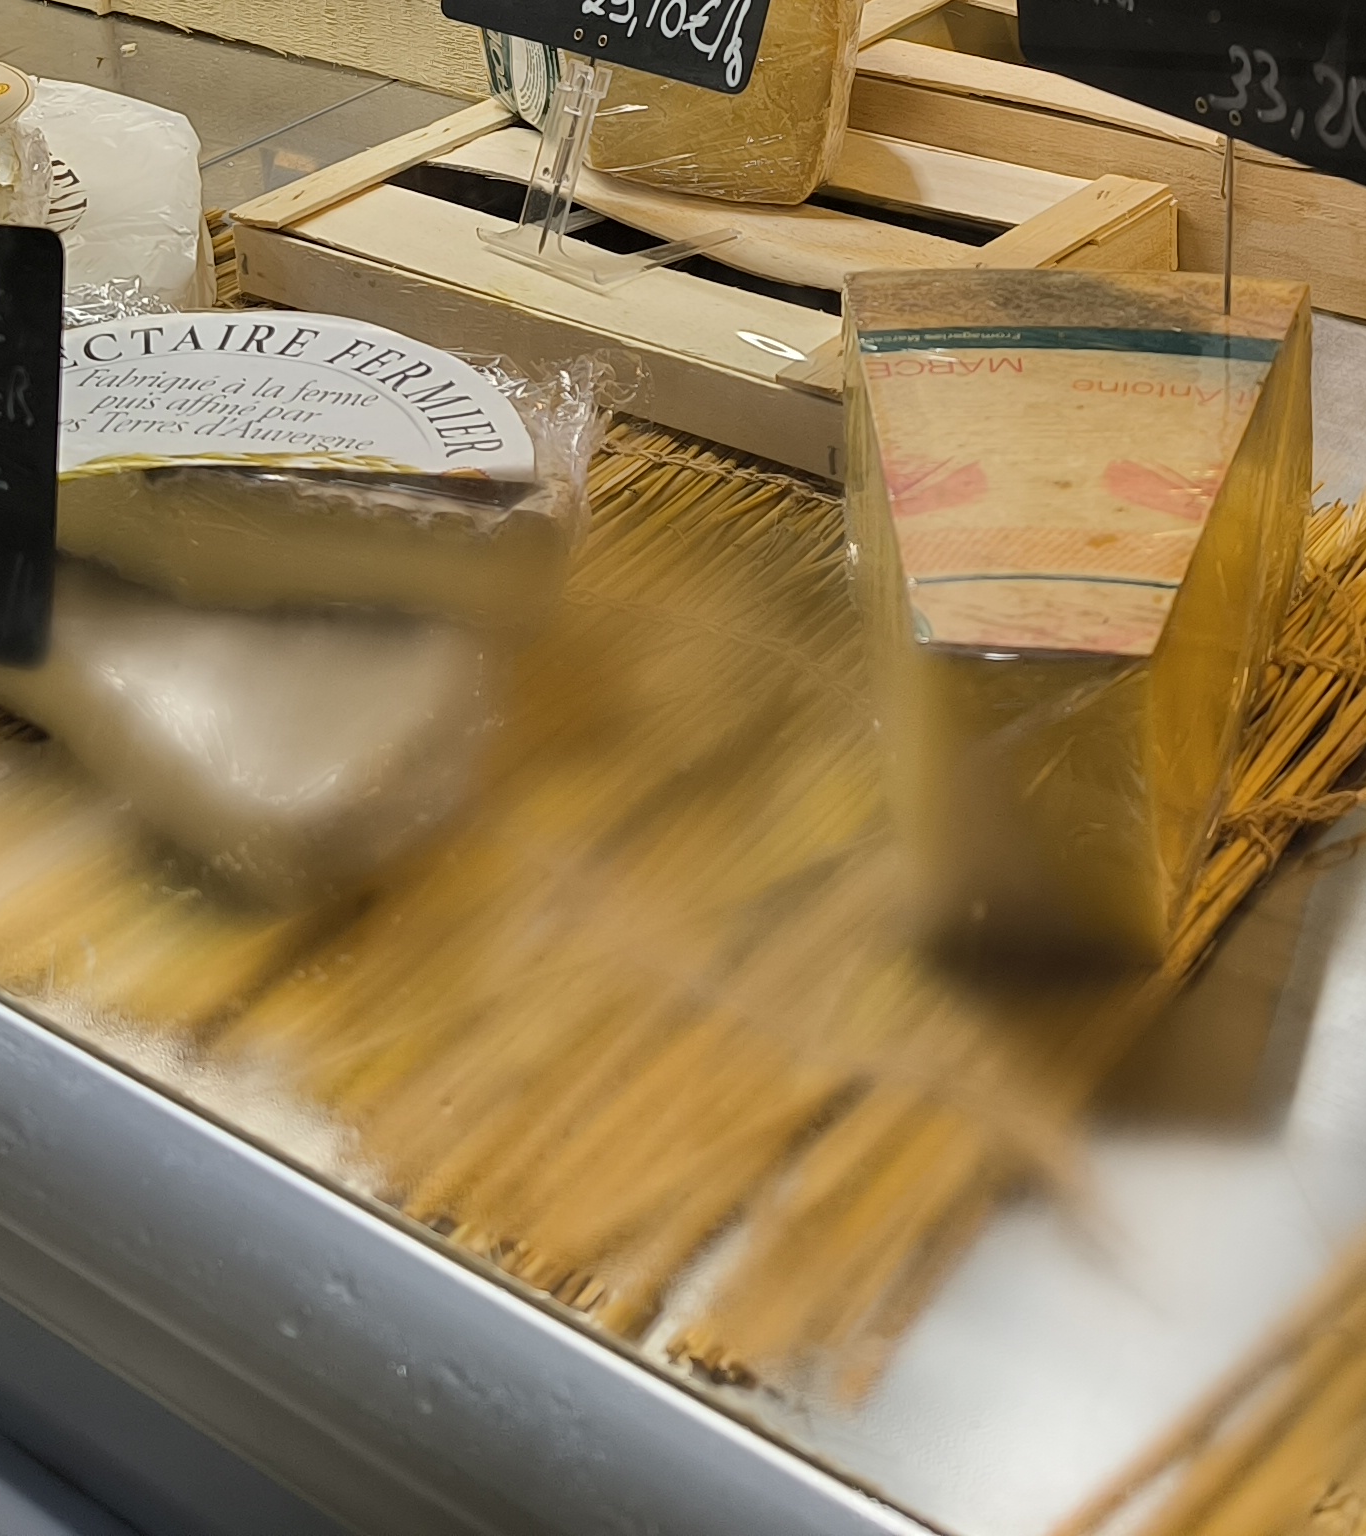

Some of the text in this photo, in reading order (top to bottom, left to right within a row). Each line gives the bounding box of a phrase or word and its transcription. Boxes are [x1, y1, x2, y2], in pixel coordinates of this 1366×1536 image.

[76, 368, 380, 409] Fabriqué à la ferme
[88, 393, 324, 424] puis affiné par
[323, 336, 505, 459] FERMIER
[1072, 376, 1222, 407] Antoine
[96, 411, 190, 436] Terres
[192, 417, 375, 453] d'Auvergne
